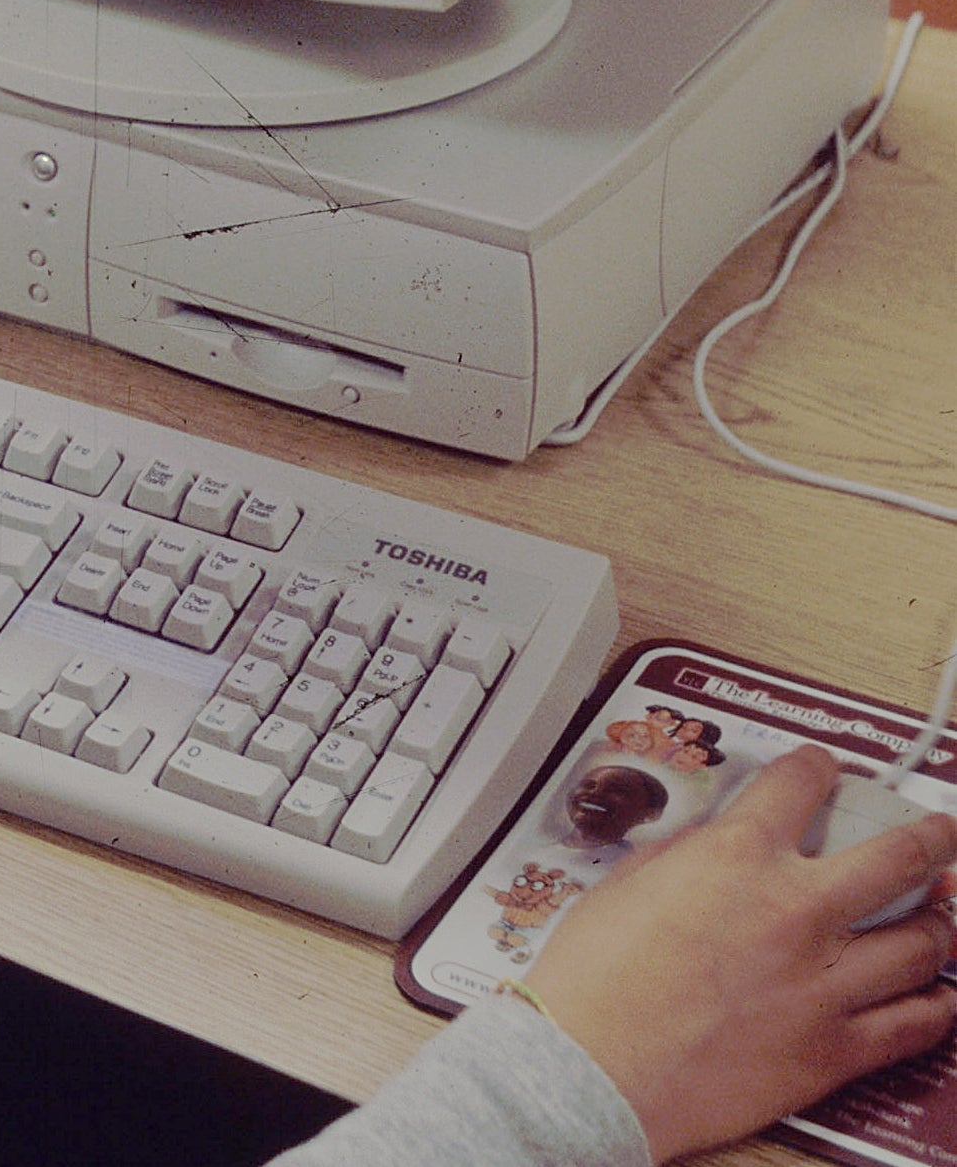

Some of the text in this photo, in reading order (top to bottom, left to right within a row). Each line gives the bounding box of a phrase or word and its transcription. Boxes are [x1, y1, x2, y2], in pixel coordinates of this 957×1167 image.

[198, 484, 220, 496] Lock
[204, 476, 229, 490] Scroll
[1, 489, 52, 512] Backspace
[251, 496, 277, 512] Pause
[246, 506, 271, 519] Break
[158, 538, 186, 554] Home
[214, 550, 240, 565] Page
[375, 538, 489, 586] TOSHIBA
[79, 562, 107, 577] Delete
[209, 560, 225, 572] Up
[296, 570, 321, 585] Num
[131, 580, 151, 593] End
[292, 578, 317, 592] Lock
[189, 591, 212, 606] Page
[181, 600, 210, 616] Down
[271, 617, 286, 630] 7
[259, 632, 288, 648] Home
[323, 634, 338, 648] 8
[380, 653, 395, 666] 9
[243, 661, 256, 673] 4
[296, 679, 311, 693] 5
[271, 720, 285, 732] 2
[712, 678, 752, 700] The
[751, 690, 846, 730] Learning
[850, 721, 950, 764] Compy
[187, 745, 202, 758] 0
[326, 738, 342, 751] 3
[446, 970, 491, 994] www
